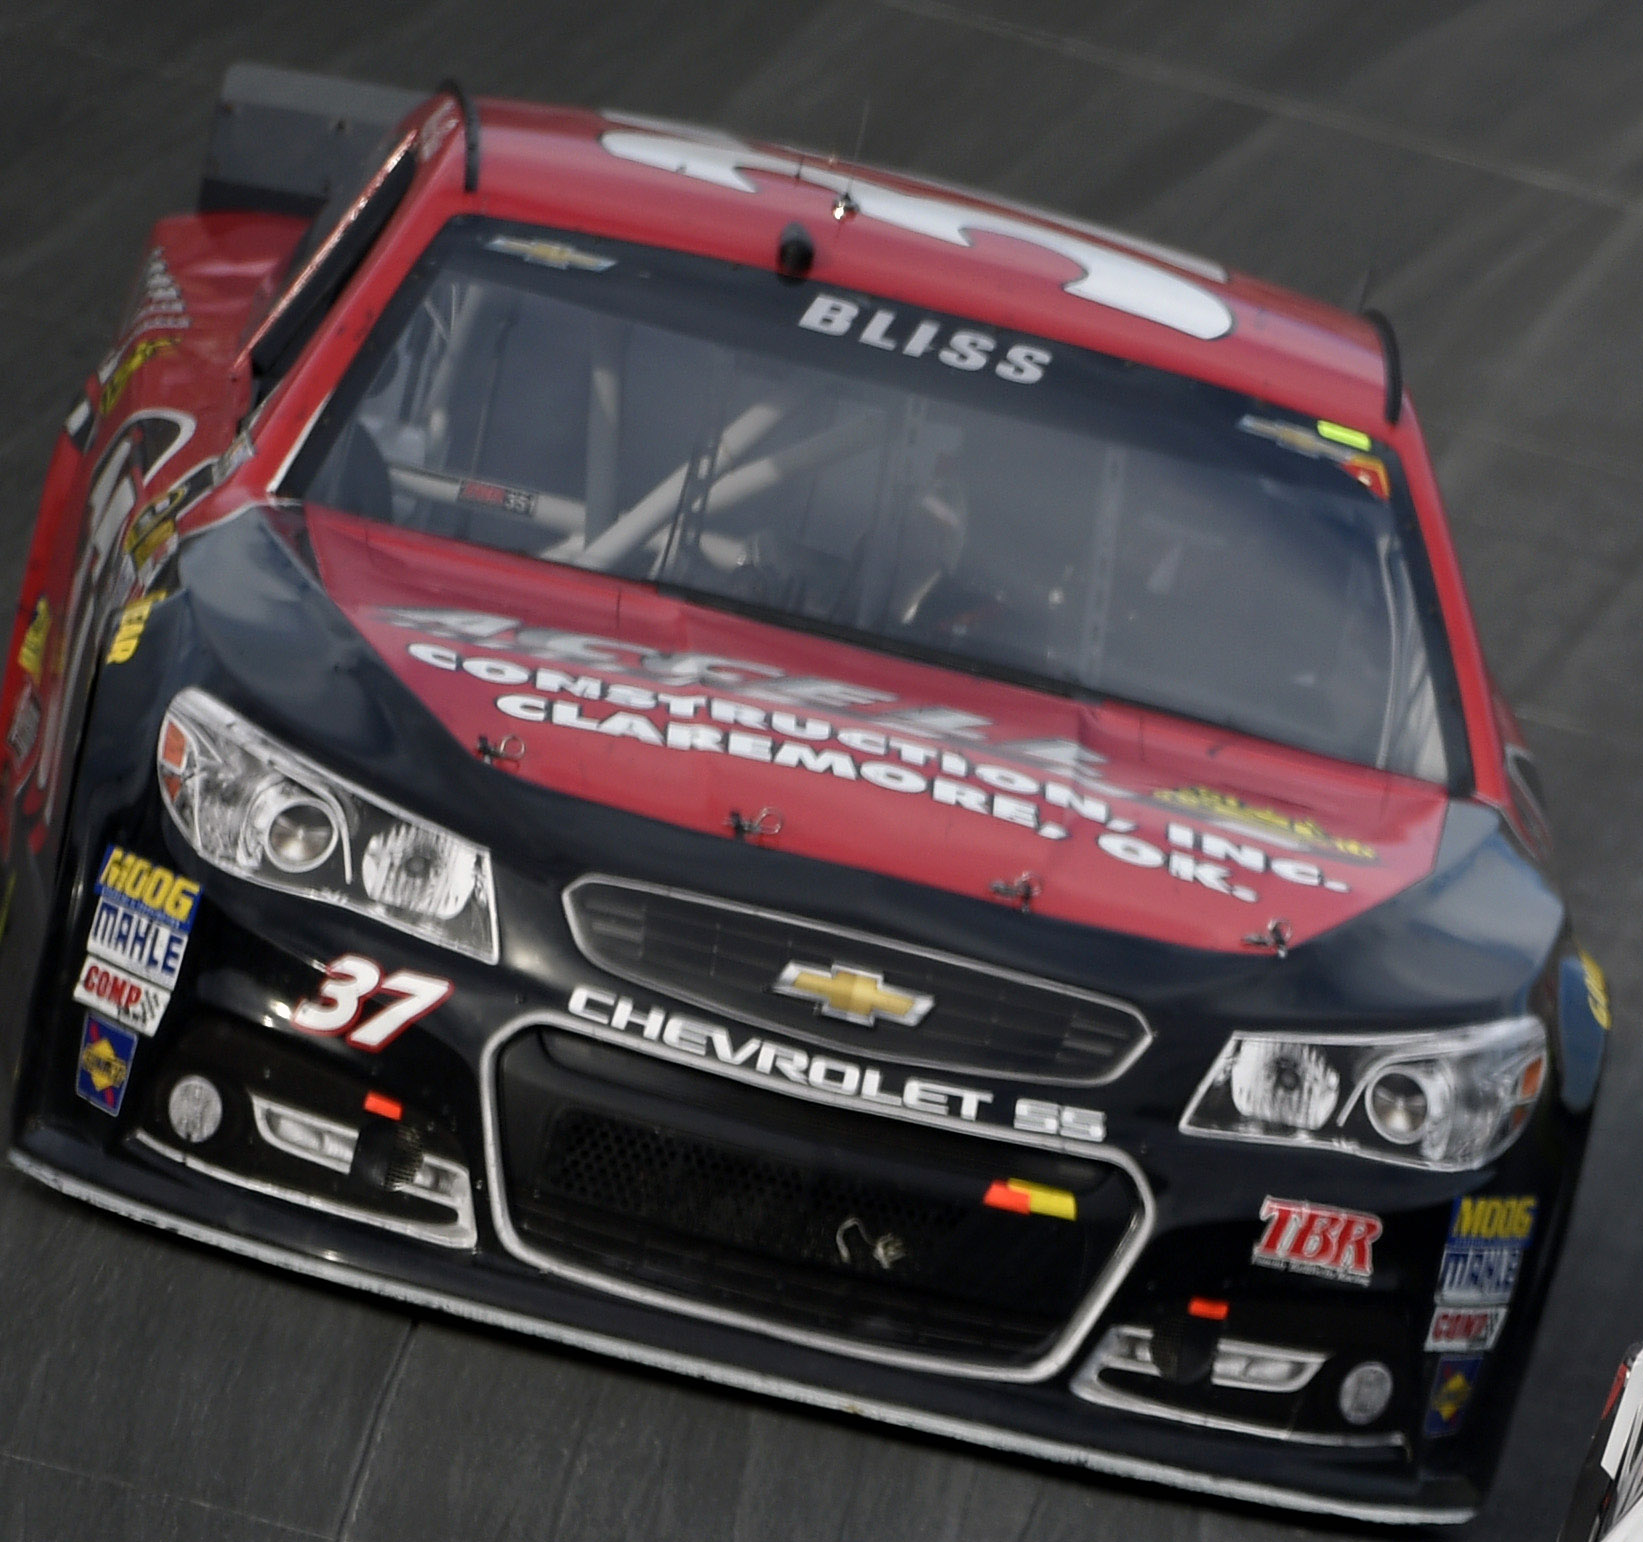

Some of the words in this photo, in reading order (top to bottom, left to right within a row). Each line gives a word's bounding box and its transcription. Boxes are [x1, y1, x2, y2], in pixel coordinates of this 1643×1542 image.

[797, 293, 1052, 385] BLISS
[101, 846, 201, 922] MOOG
[1166, 822, 1350, 893] INC.
[93, 902, 183, 974] MAHLE
[83, 965, 142, 1010] COMP
[292, 954, 454, 1052] 37
[568, 985, 994, 1122] CHEVROLET
[1013, 1098, 1107, 1143] SS
[1259, 1195, 1383, 1277] TBR
